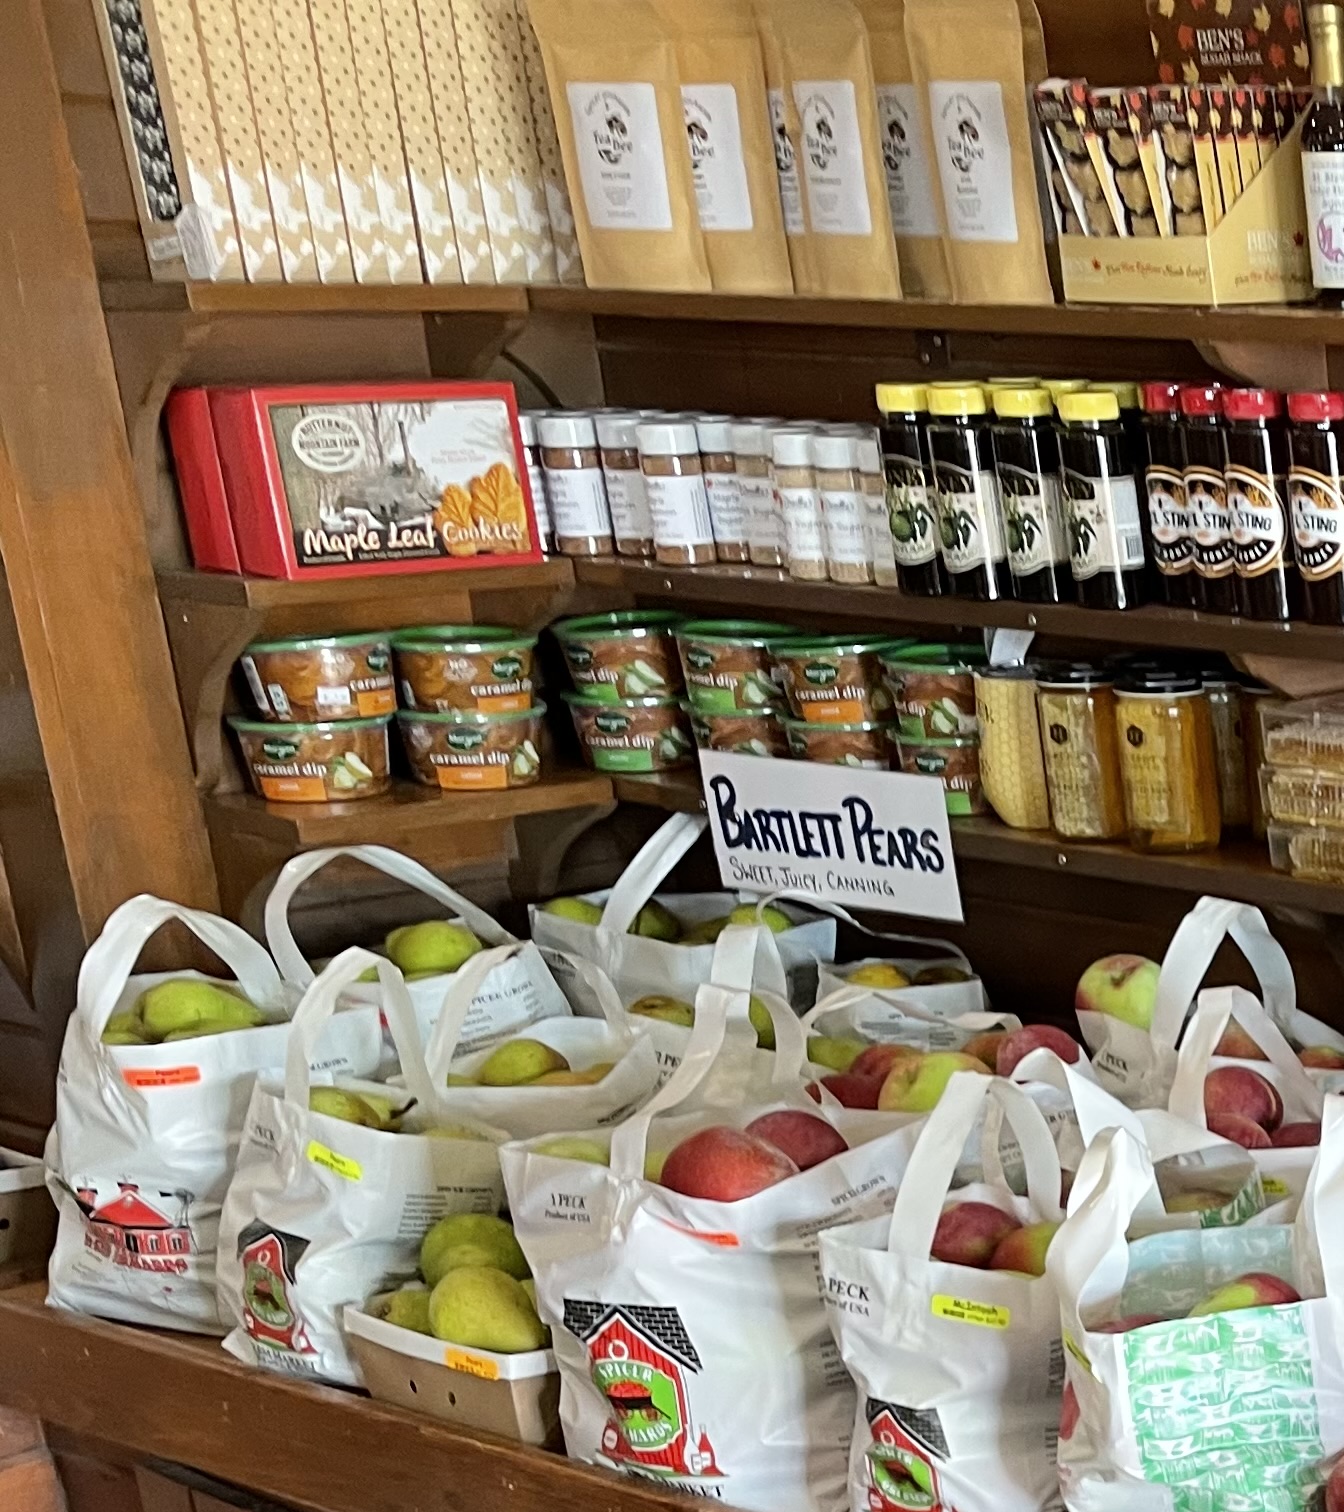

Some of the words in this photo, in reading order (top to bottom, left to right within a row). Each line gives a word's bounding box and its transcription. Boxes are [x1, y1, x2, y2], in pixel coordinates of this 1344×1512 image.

[1196, 27, 1245, 51] BEN'S
[1303, 515, 1337, 533] STING
[303, 523, 381, 561] Maple
[387, 513, 437, 549] Leaf
[442, 515, 523, 543] Cookies
[845, 686, 865, 701] dip
[633, 735, 654, 749] dip
[430, 752, 484, 765] caramel
[488, 751, 510, 765] dip
[302, 763, 327, 777] dip
[709, 774, 846, 861] BARTLETT
[842, 795, 945, 875] PEARS
[729, 856, 778, 887] SWEET,
[780, 867, 822, 893] JUICY,
[827, 870, 896, 897] CANNING
[558, 1193, 586, 1210] PECK
[828, 1277, 870, 1302] PECK
[849, 1303, 870, 1317] USA
[598, 1362, 655, 1382] SPICER
